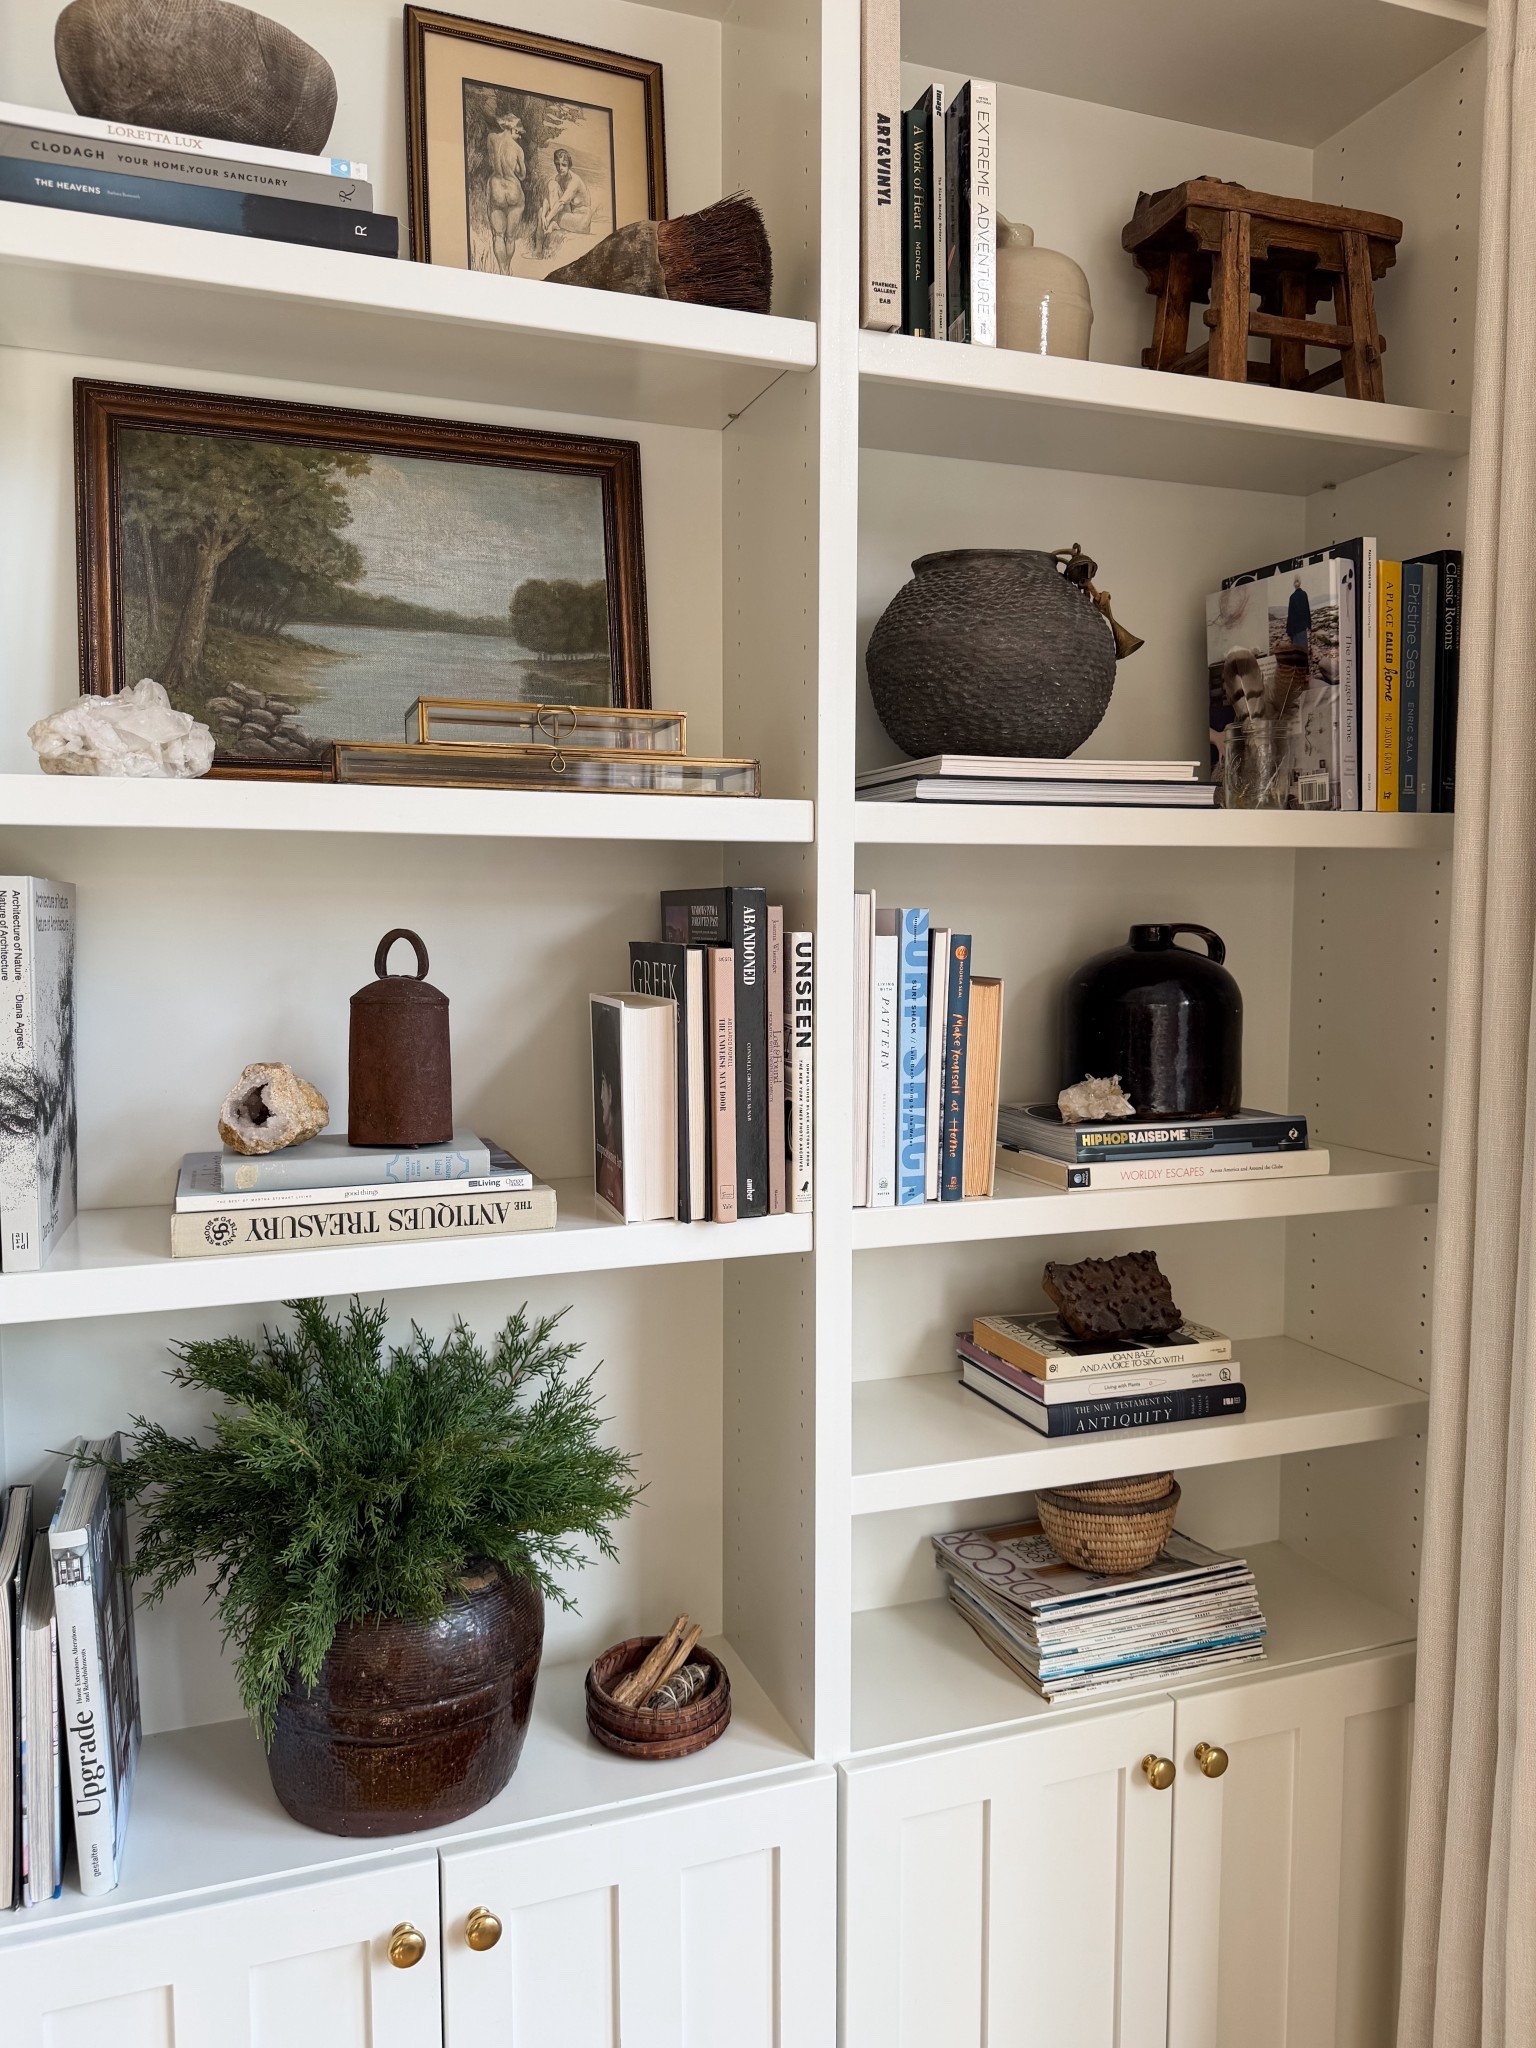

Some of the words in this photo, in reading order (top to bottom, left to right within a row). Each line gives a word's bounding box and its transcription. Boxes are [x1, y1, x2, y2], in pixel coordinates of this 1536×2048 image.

[107, 125, 171, 145] LORETTA
[175, 137, 204, 149] LUX
[914, 125, 925, 136] A
[30, 140, 105, 160] CLODAGH
[914, 141, 925, 174] Work
[977, 110, 990, 197] EXTREME
[118, 155, 149, 167] YOUR
[224, 171, 288, 187] SANCTUARY
[914, 177, 925, 192] of
[35, 177, 53, 188] THE
[56, 181, 101, 195] HEAVENS
[914, 194, 925, 230] Heart
[355, 225, 367, 236] R
[977, 202, 990, 316] ADVENTURE
[872, 281, 898, 290] FRAENKEL
[874, 287, 896, 295] GALLERY
[1386, 581, 1394, 589] A
[1445, 562, 1457, 604] Classic
[1407, 583, 1420, 645] Pristine
[1445, 607, 1456, 650] Rooms
[1345, 635, 1353, 656] The
[1385, 631, 1394, 664] CALLED
[1344, 659, 1353, 705] Foraged
[1406, 650, 1418, 688] Seas
[1384, 666, 1398, 702] home
[1385, 712, 1392, 722] MR
[1407, 702, 1415, 732] ENRIC
[12, 890, 21, 941] Architecture
[771, 919, 779, 941] Joanna
[0, 930, 9, 980] Architecture
[13, 942, 22, 951] of
[743, 905, 756, 986] ABANDONED
[14, 952, 22, 981] Nature
[632, 960, 678, 1000] GREEK
[16, 994, 24, 1019] Diana
[795, 942, 812, 1048] UNSEEN
[15, 1021, 25, 1049] Agrest
[773, 1030, 781, 1048] Lost
[881, 997, 890, 1070] PATTERN
[952, 1013, 967, 1047] Make
[719, 1071, 727, 1089] NEXT
[774, 1055, 782, 1084] Found
[950, 1049, 963, 1095] Yourself
[719, 1091, 727, 1112] DOOR
[951, 1099, 959, 1112] at
[902, 1049, 926, 1204] SHACK
[948, 1117, 960, 1158] Home
[434, 1159, 442, 1175] Island
[445, 1155, 453, 1180] Treasure
[1120, 1168, 1163, 1181] WORLDLY
[1166, 1167, 1205, 1179] ESCAPES
[344, 1189, 359, 1198] good
[359, 1188, 379, 1197] things
[477, 1180, 501, 1188] Living
[746, 1178, 755, 1201] amber
[389, 1201, 511, 1232] ANTIQUES
[514, 1200, 533, 1211] THE
[204, 1219, 215, 1246] BOOKS
[221, 1216, 238, 1247] GARLAND
[245, 1210, 380, 1242] TREASURY
[1080, 1364, 1100, 1373] AND
[1107, 1361, 1130, 1369] VOICE
[1142, 1358, 1161, 1366] SING
[1162, 1354, 1184, 1364] WITH
[1110, 1352, 1133, 1361] JOAN
[1134, 1350, 1155, 1359] BAEZ
[1074, 1405, 1090, 1414] THE
[1093, 1403, 1112, 1413] NEW
[1115, 1397, 1160, 1409] TESTAMENT
[1163, 1395, 1172, 1403] IN
[1076, 1408, 1172, 1432] ANTIQUITY
[941, 1532, 1053, 1596] DECOR
[81, 1648, 89, 1692] Refurbishments
[73, 1686, 82, 1705] Home
[70, 1709, 106, 1817] Upgrade
[90, 1843, 101, 1877] gestalten
